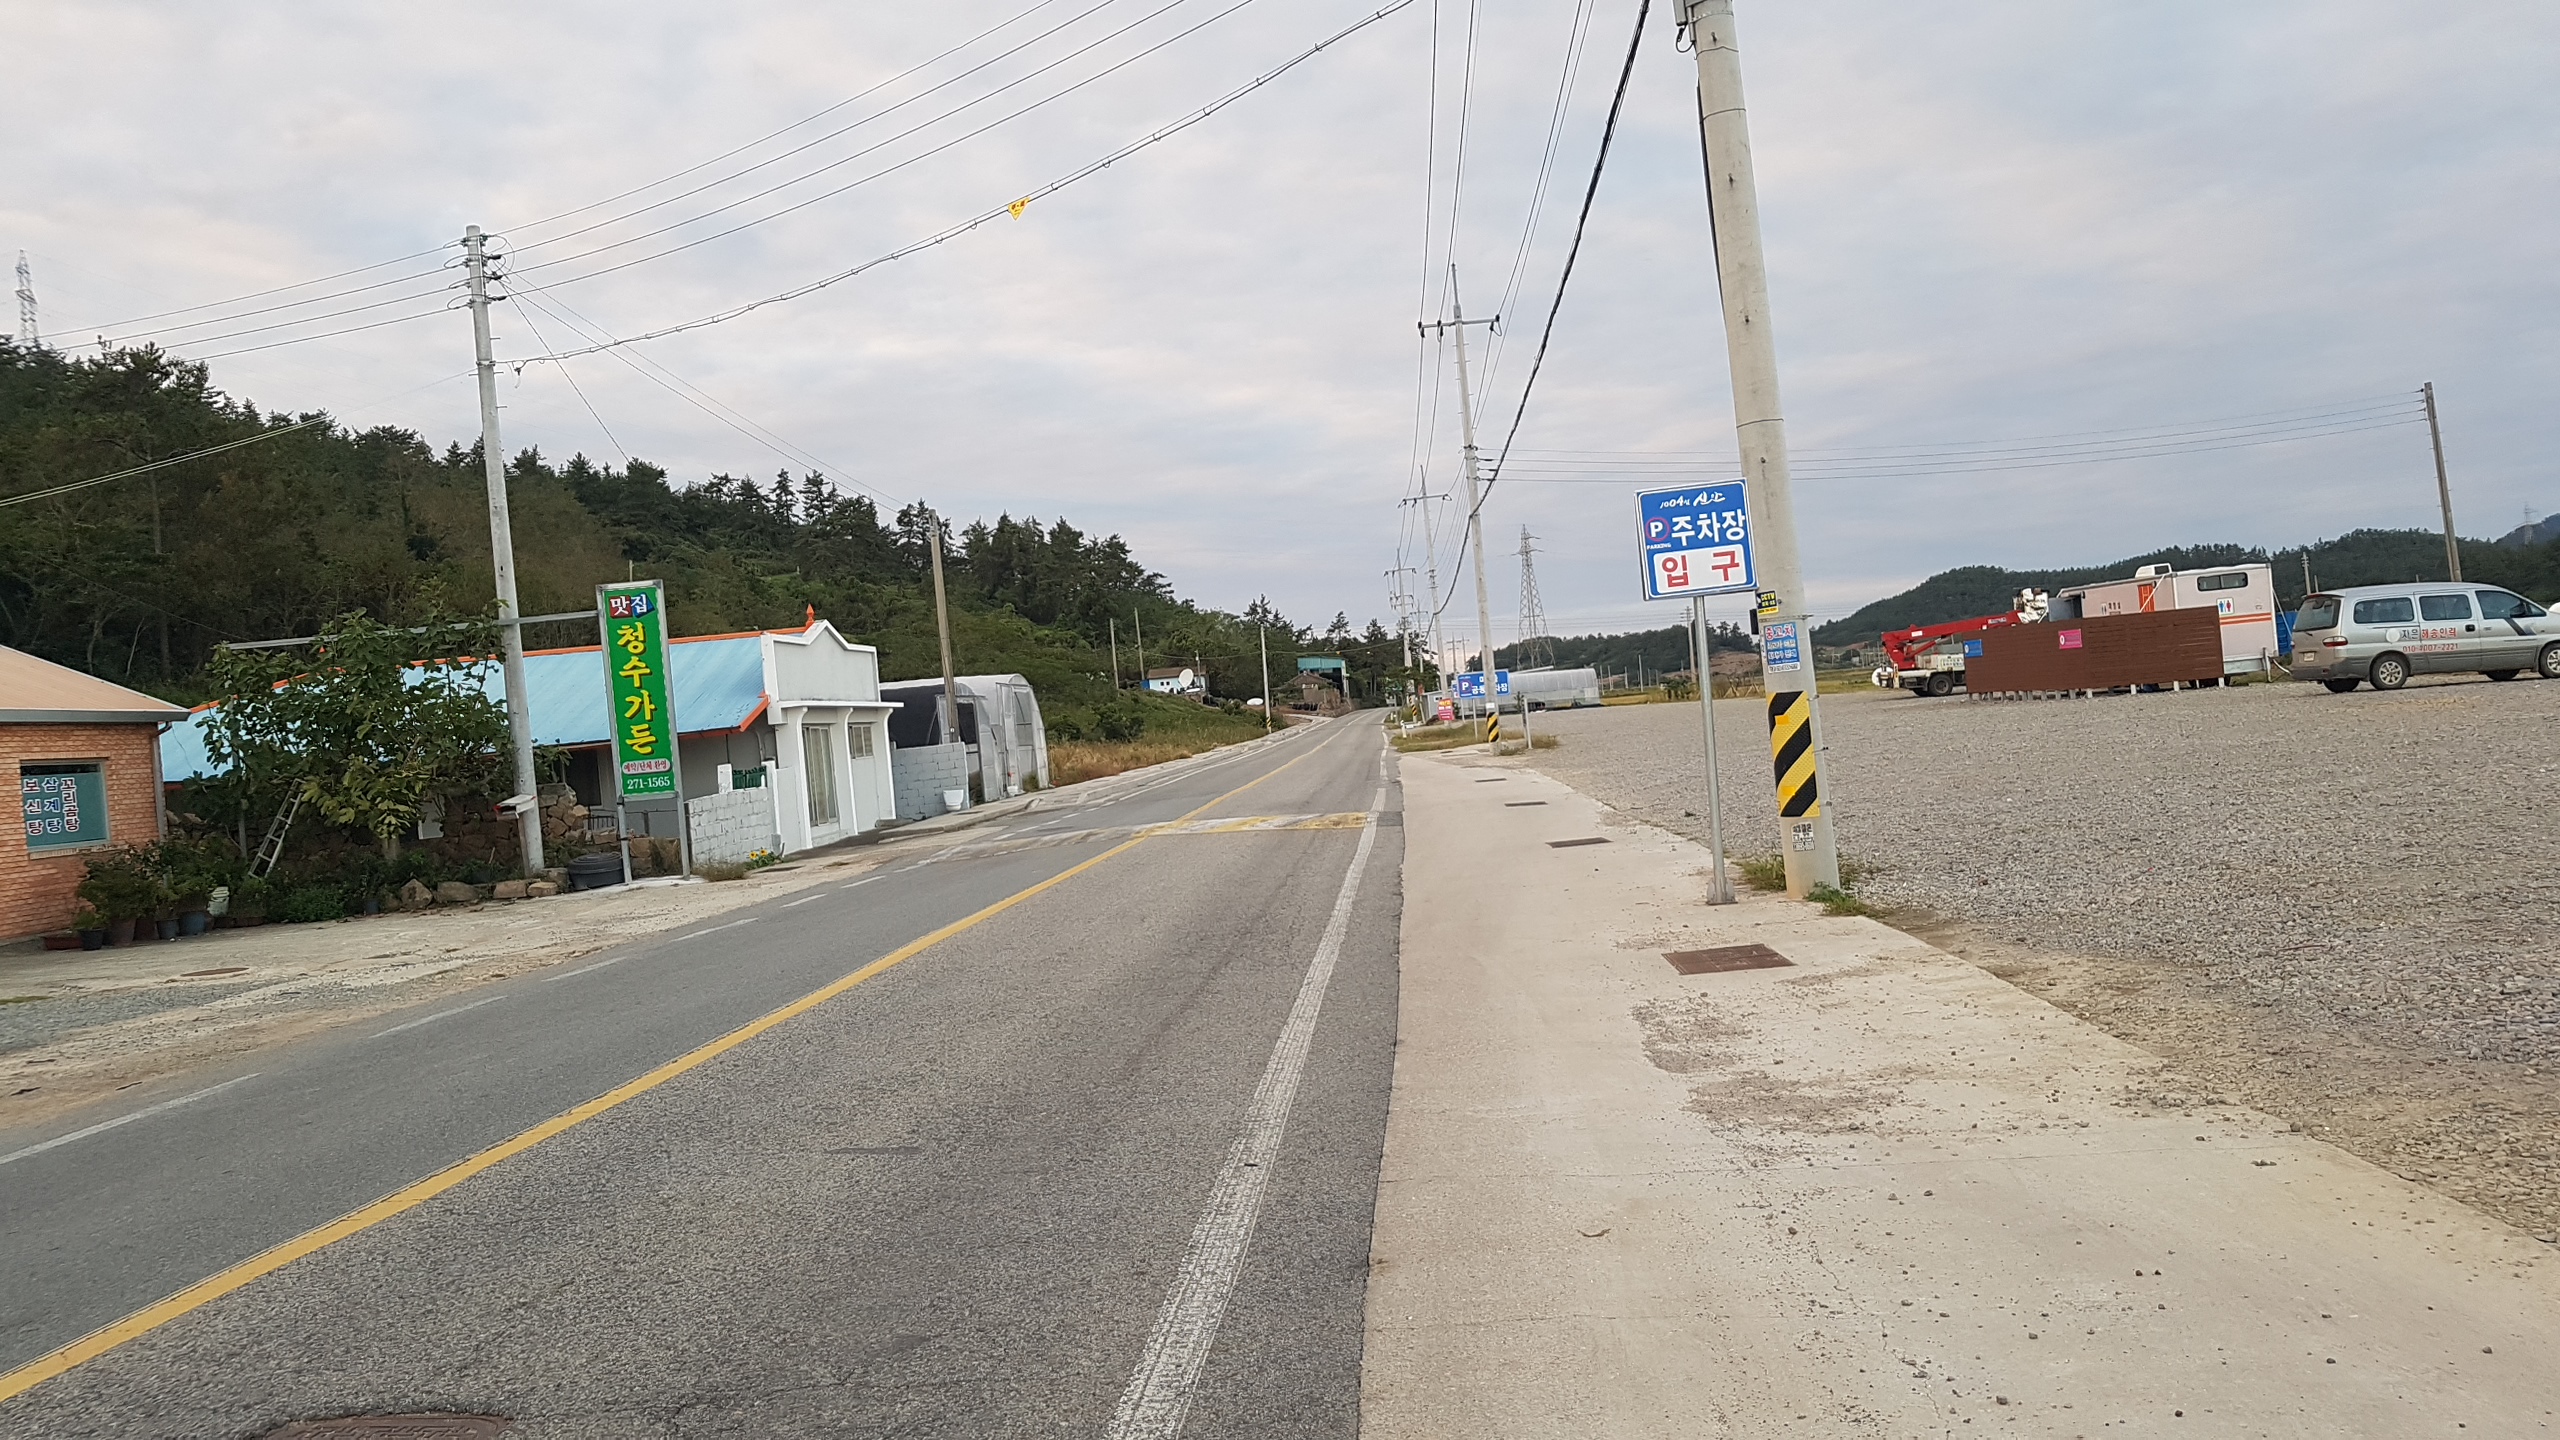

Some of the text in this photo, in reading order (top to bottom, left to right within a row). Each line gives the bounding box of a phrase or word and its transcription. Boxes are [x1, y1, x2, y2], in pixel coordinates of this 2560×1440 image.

[1671, 508, 1745, 546] 주차장
[609, 593, 648, 616] 맛집
[1765, 624, 1795, 640] 중고차
[617, 622, 656, 754] 청수가든
[43, 778, 61, 832] 삼계탕
[61, 777, 79, 831] 꼬리곰탕
[627, 776, 671, 790] 271-1565
[23, 779, 43, 835] 보신탕
